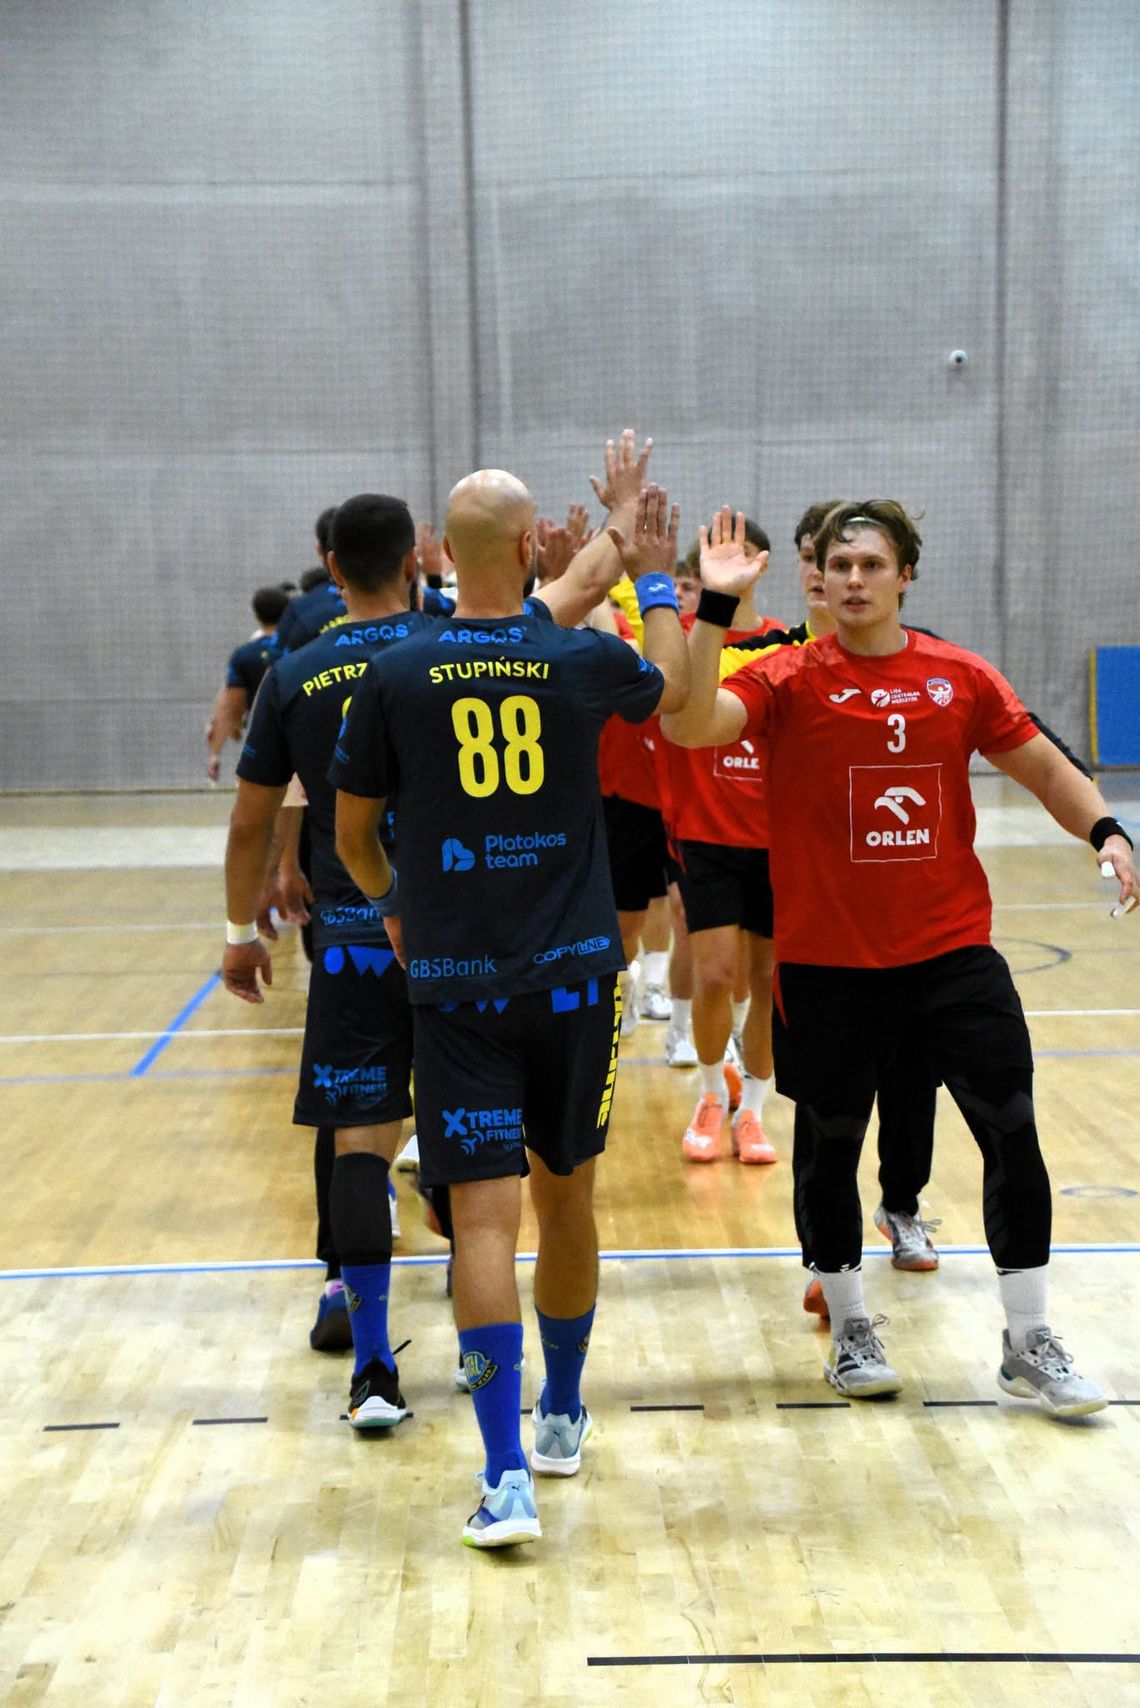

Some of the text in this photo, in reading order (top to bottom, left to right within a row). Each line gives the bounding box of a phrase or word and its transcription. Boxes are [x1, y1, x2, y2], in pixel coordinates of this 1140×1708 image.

[429, 656, 549, 684] STUPIŃSKI
[451, 694, 545, 798] 88
[887, 713, 906, 754] 3
[866, 829, 930, 847] ORLEN
[485, 853, 538, 869] team
[410, 954, 497, 979] GBSBank
